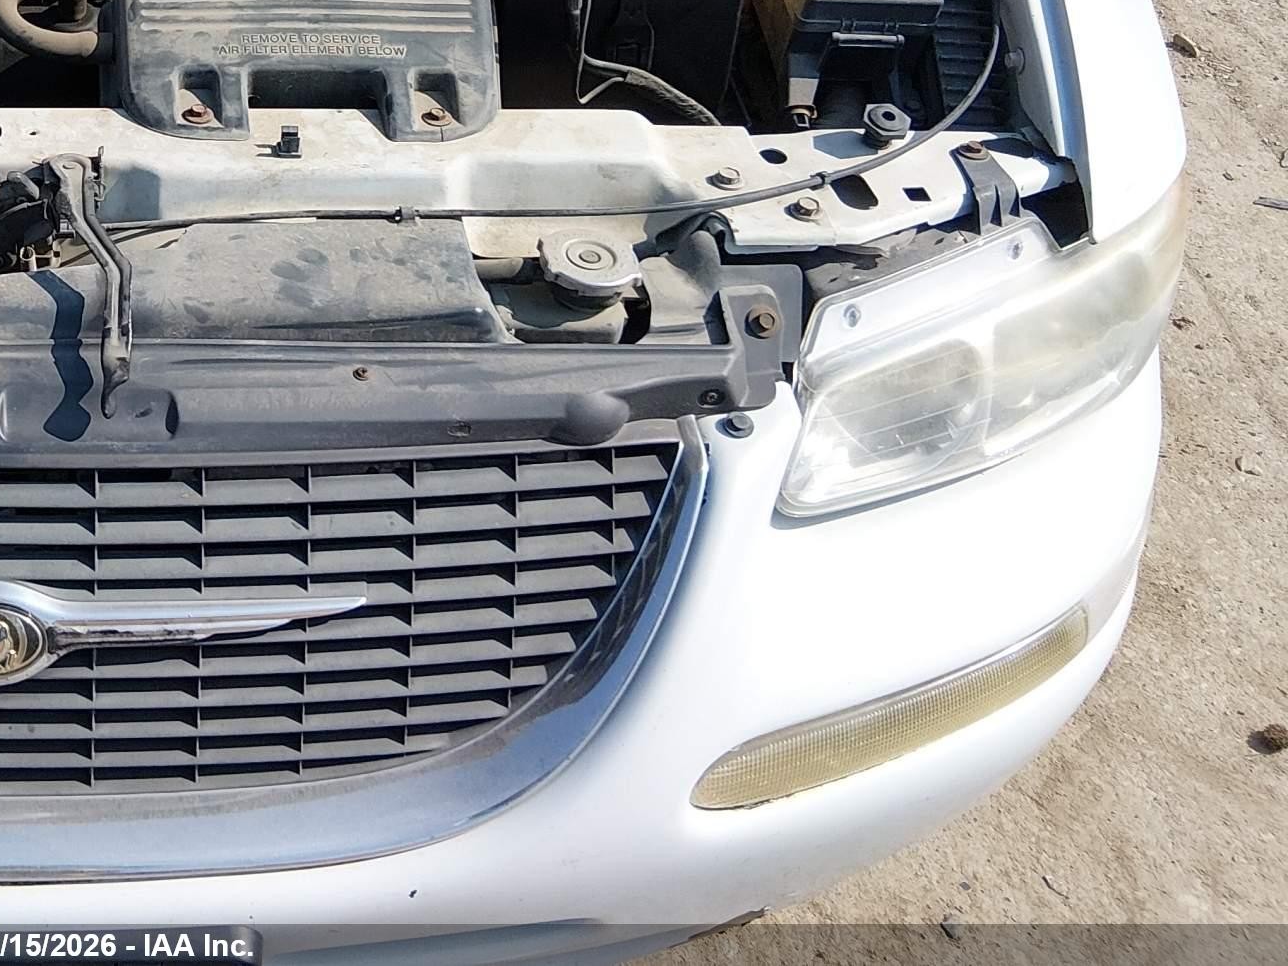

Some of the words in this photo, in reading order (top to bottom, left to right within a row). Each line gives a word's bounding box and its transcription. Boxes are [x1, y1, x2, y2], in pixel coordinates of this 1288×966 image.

[242, 34, 297, 44] REMOVE
[302, 34, 320, 44] TO
[324, 34, 380, 45] SERVICE
[218, 46, 239, 55] AIR
[244, 45, 287, 55] FILTER
[292, 45, 353, 55] ELEMENT
[358, 46, 407, 57] BELOW
